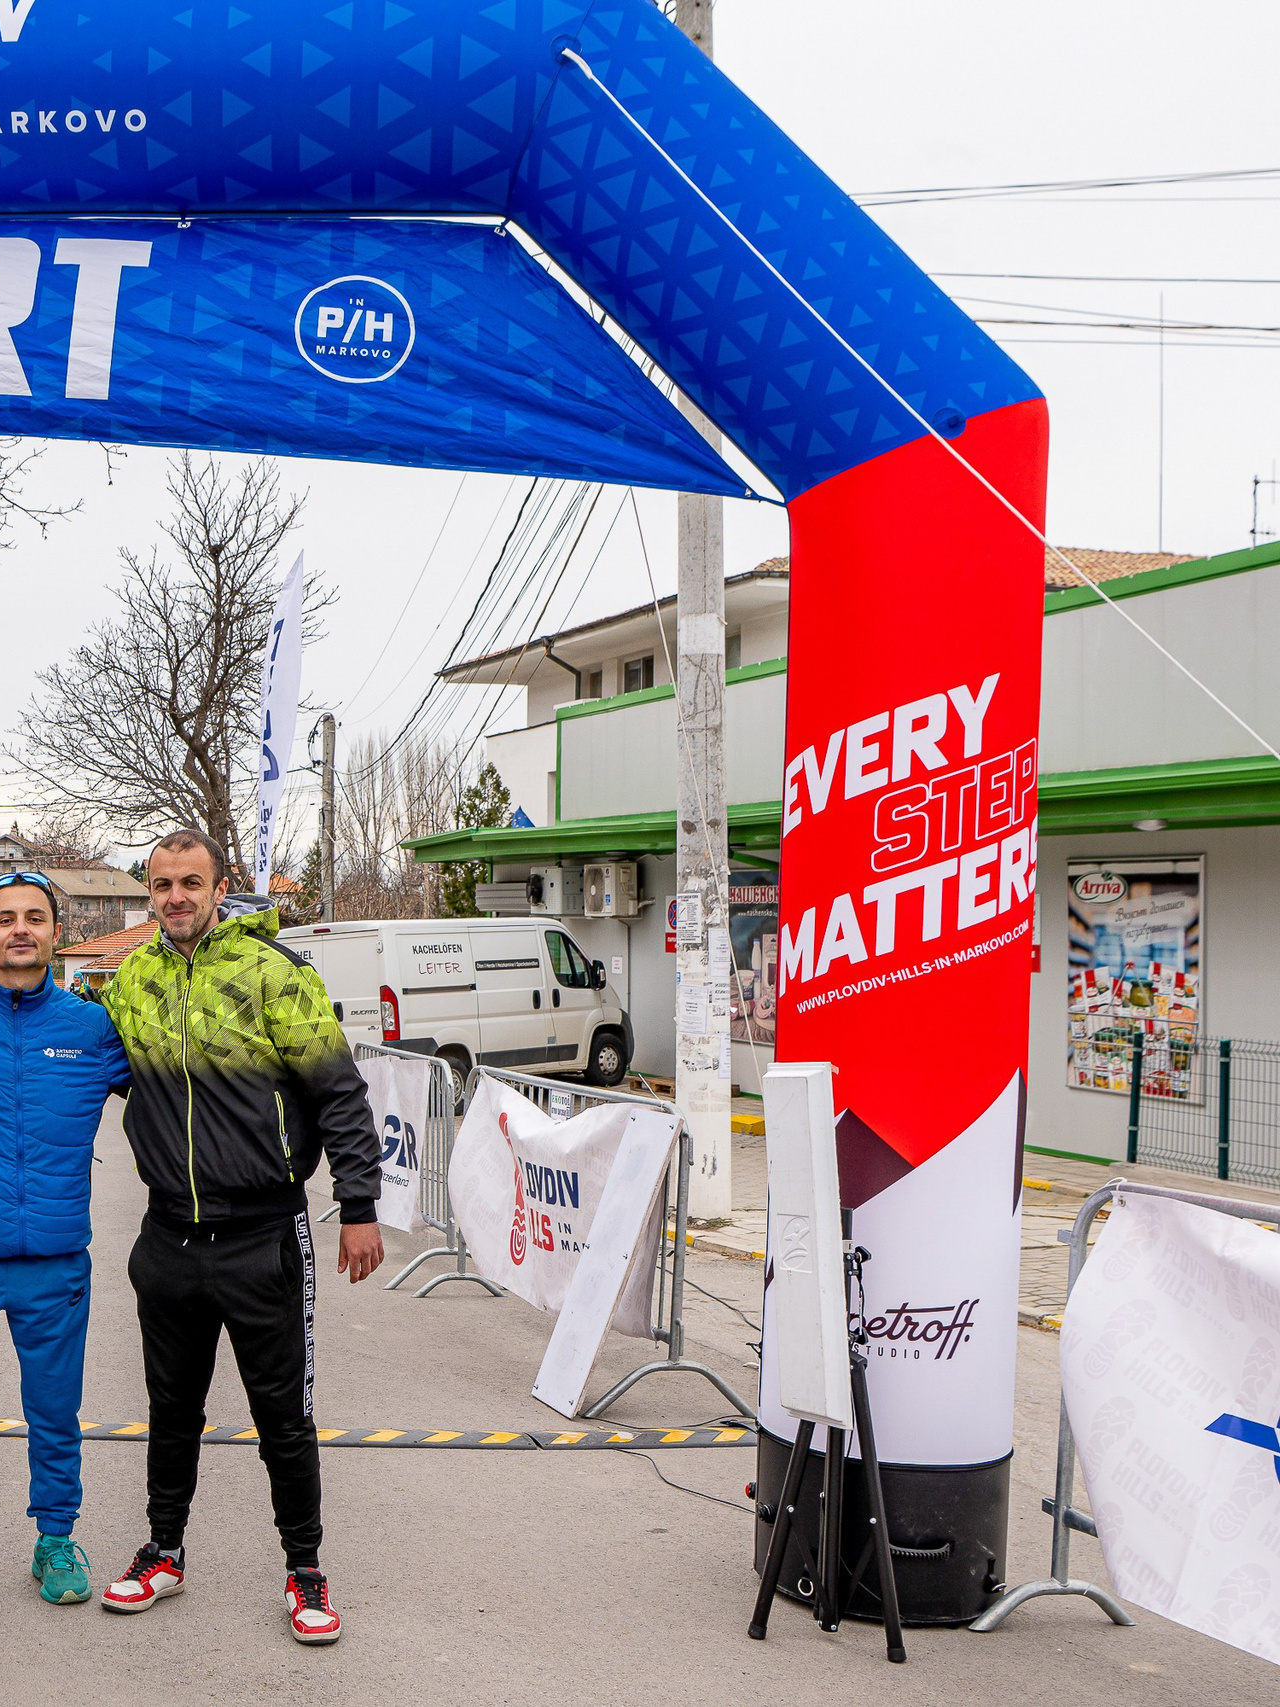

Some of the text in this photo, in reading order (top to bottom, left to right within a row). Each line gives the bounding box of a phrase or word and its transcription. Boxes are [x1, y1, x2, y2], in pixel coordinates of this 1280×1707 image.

[349, 298, 364, 306] IN
[317, 306, 394, 344] P/H
[316, 345, 392, 359] MARKOVO
[783, 672, 1001, 838] EVERY
[871, 738, 1037, 872] STEP
[1079, 879, 1121, 896] Arriva
[412, 943, 463, 955] KACHELÖFEN
[418, 961, 463, 975] LEITER
[797, 919, 1029, 1014] WWW.PLOVDIV-HILLS-IN-MARKOVO.COM
[558, 1222, 572, 1235] IN
[853, 1343, 920, 1360] STUDIO
